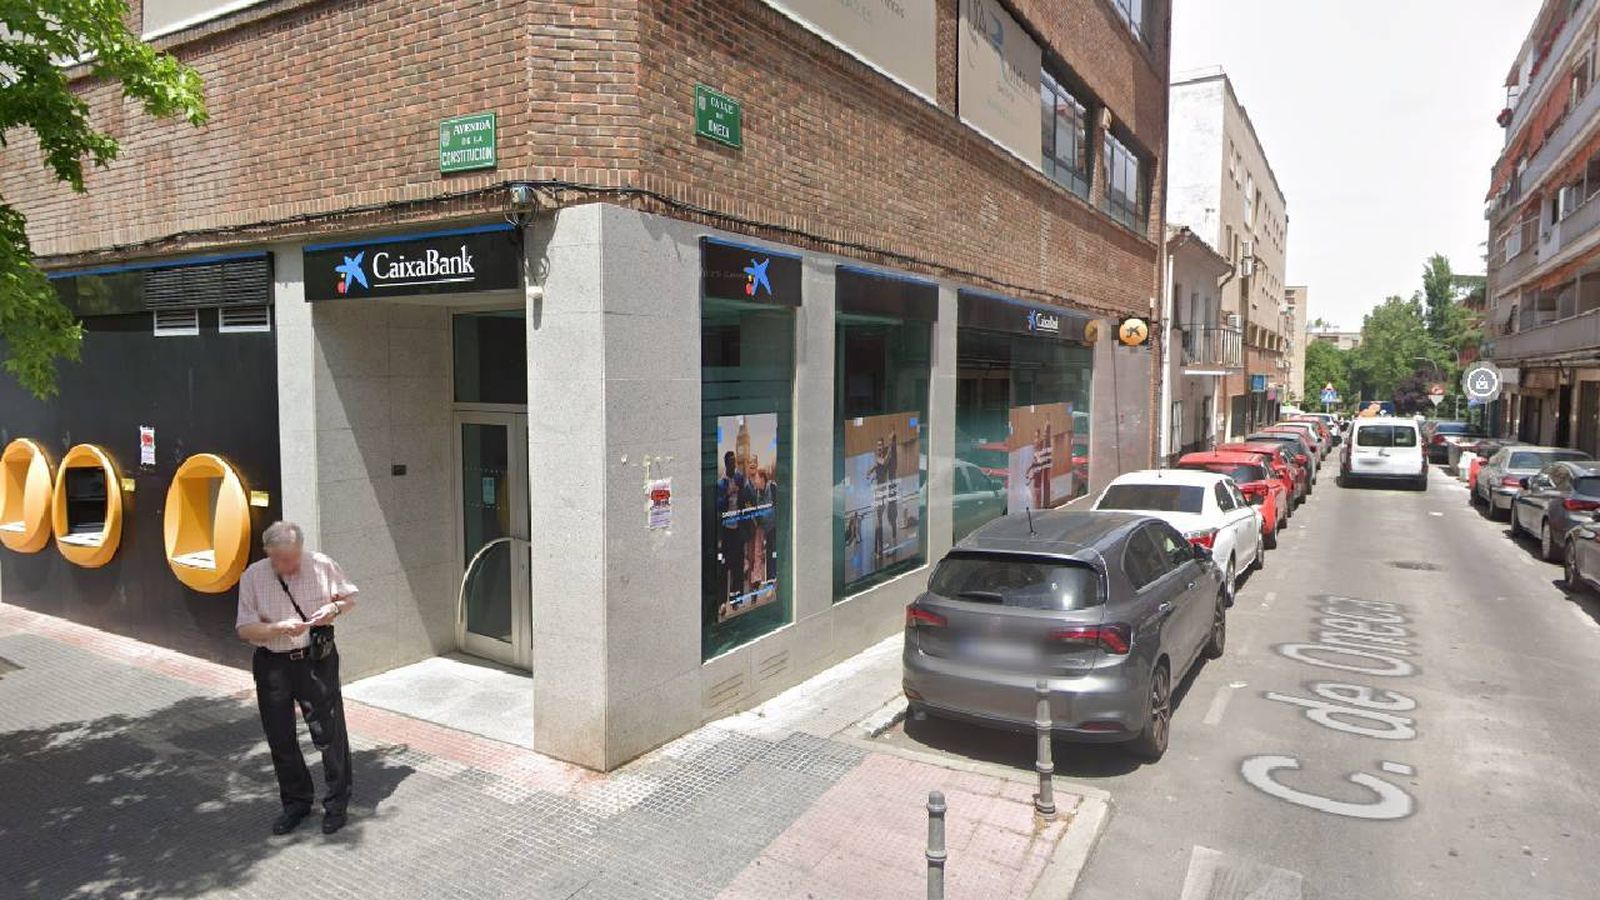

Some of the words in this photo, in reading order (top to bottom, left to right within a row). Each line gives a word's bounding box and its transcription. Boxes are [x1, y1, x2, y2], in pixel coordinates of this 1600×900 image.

[710, 96, 734, 115] CALLE
[453, 119, 492, 136] AVENIDA
[473, 135, 483, 144] LA
[373, 245, 475, 279] CaixaBank
